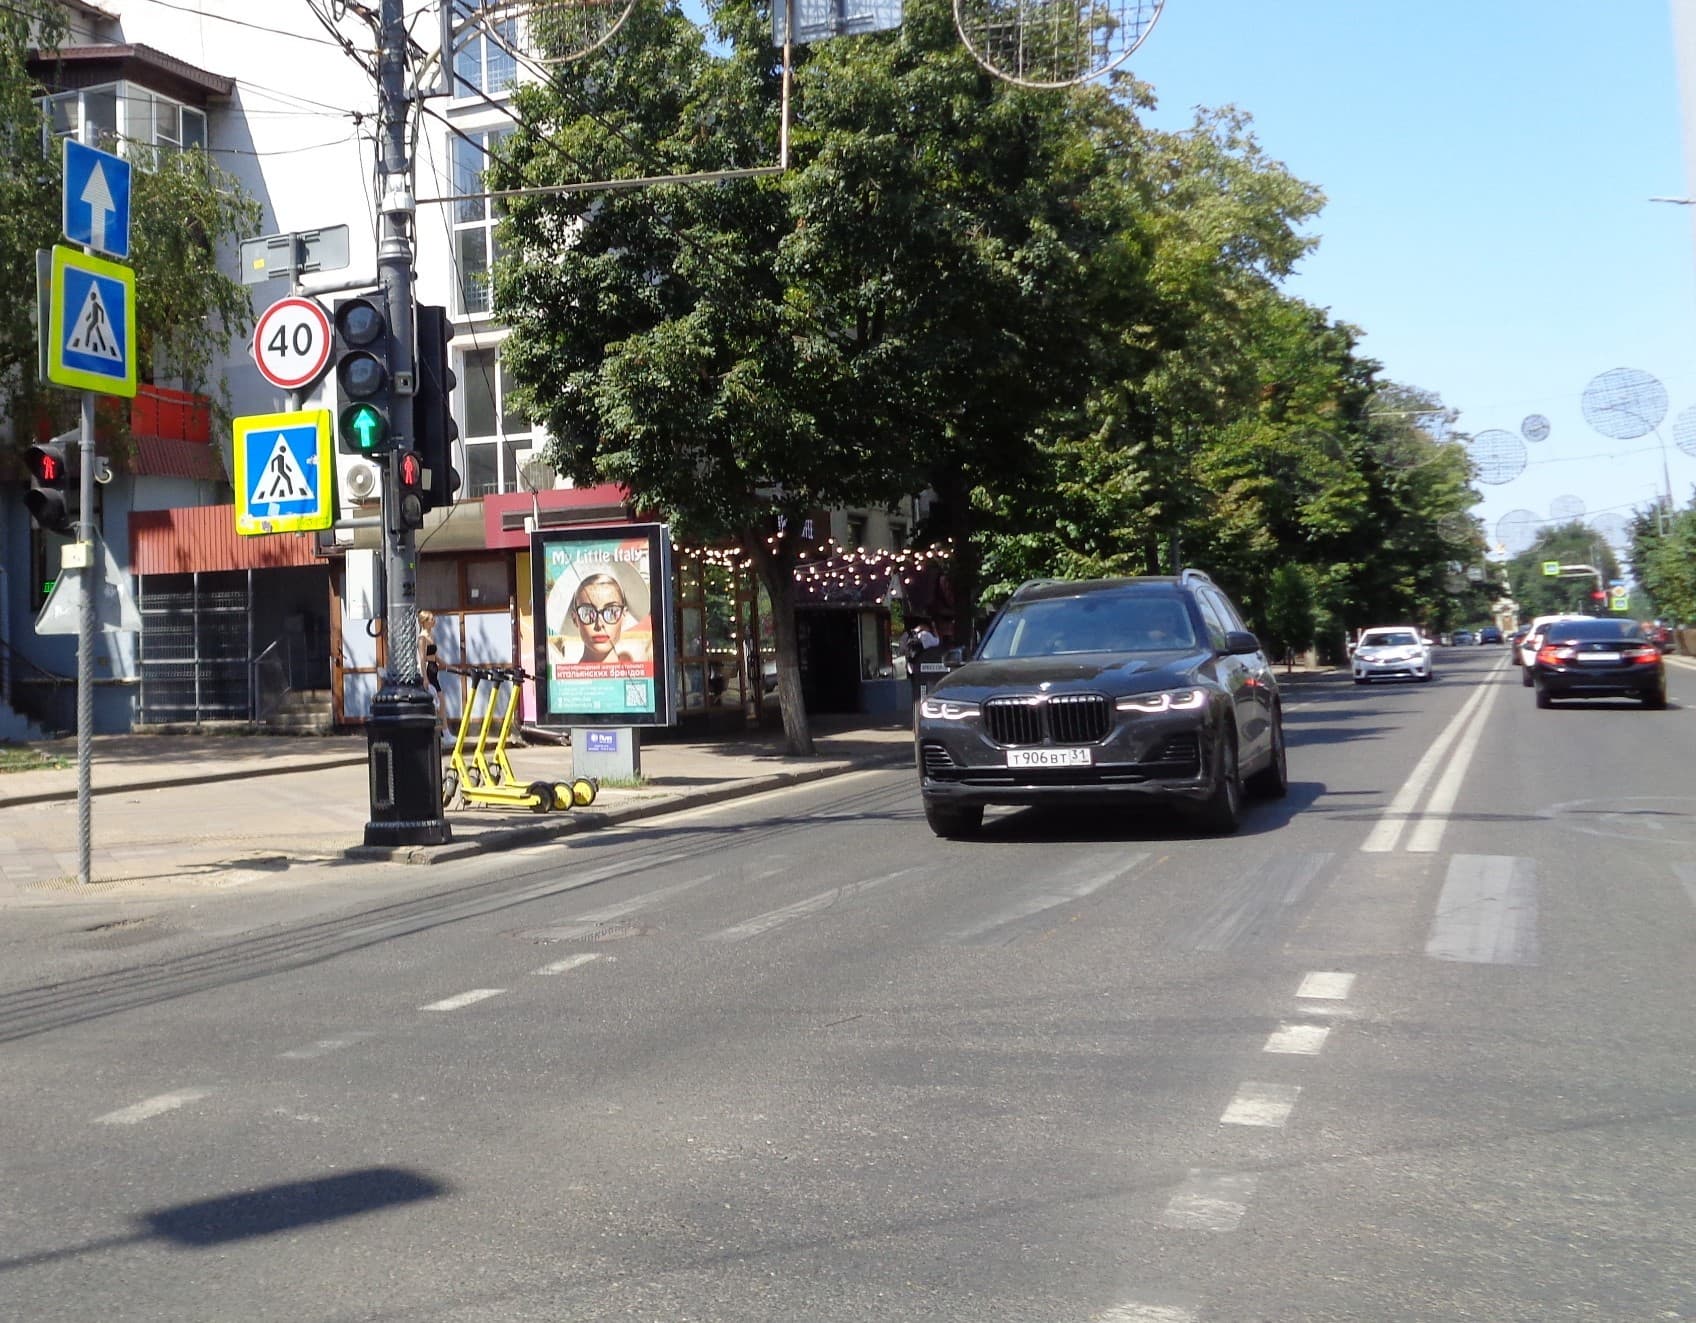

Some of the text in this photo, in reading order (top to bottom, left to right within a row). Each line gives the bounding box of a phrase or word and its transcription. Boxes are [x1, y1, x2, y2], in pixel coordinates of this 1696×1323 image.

[268, 322, 313, 357] 40
[552, 546, 642, 566] My Little Italy
